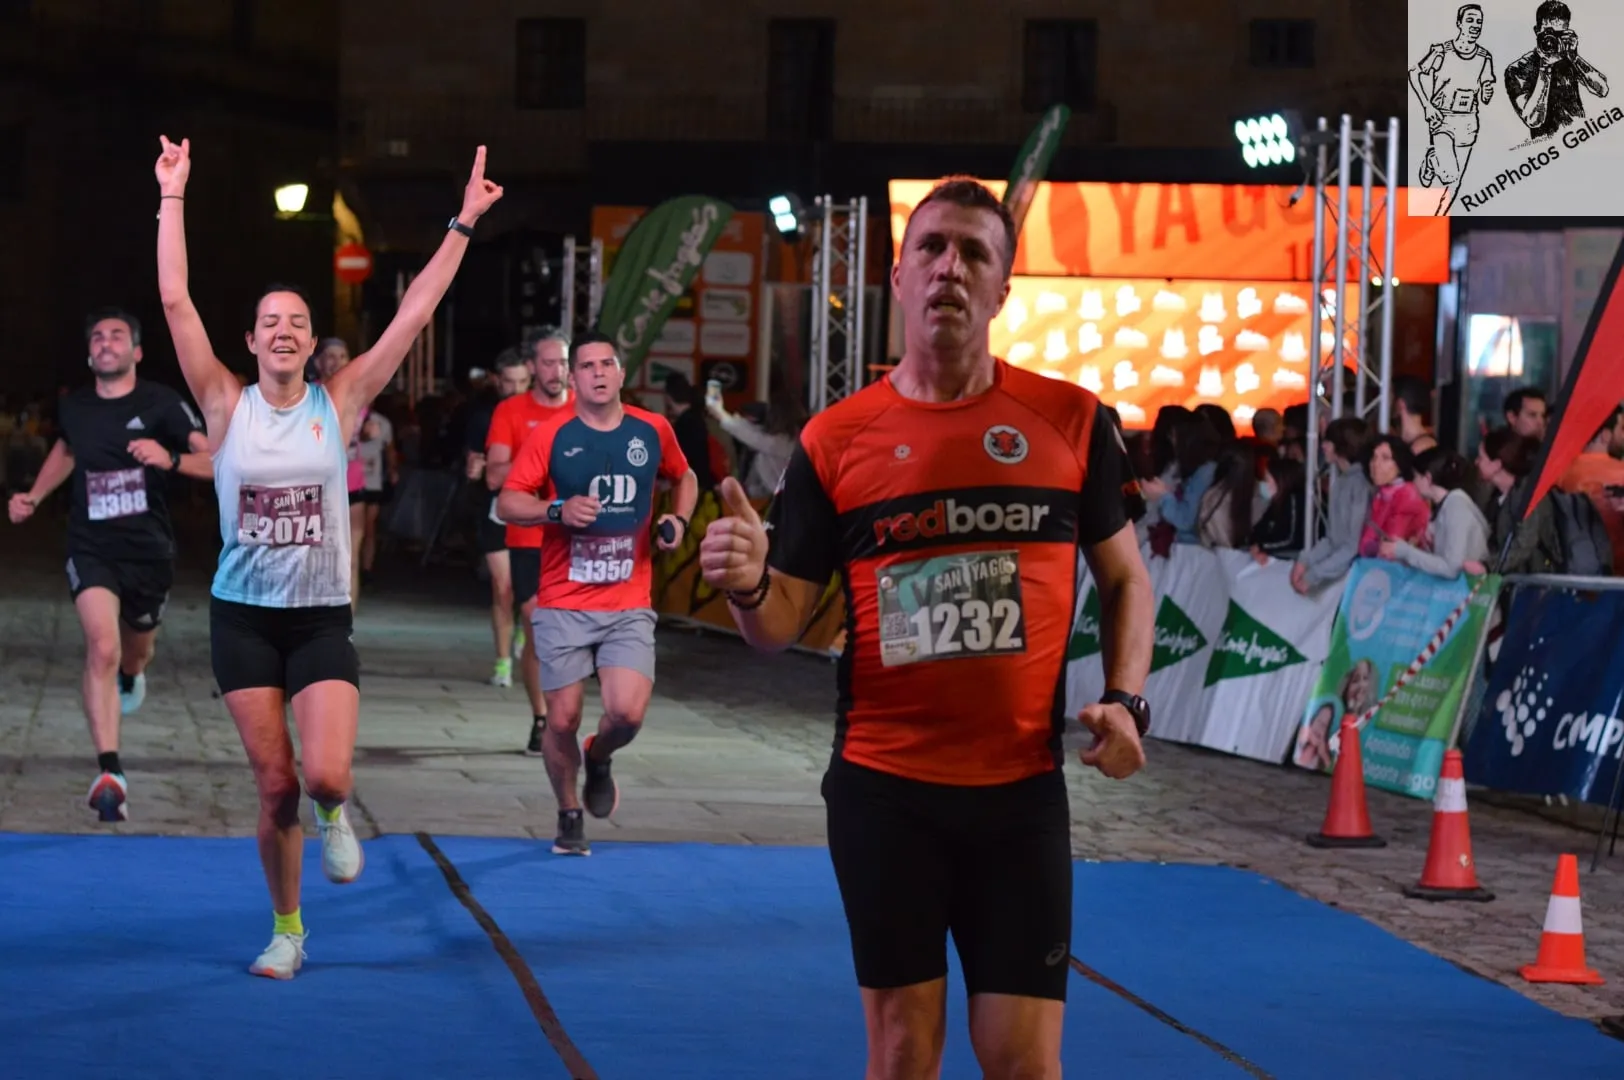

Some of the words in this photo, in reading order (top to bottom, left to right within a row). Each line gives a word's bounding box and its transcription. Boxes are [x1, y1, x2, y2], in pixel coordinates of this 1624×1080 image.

[588, 474, 637, 505] CD
[258, 514, 322, 544] 2074
[873, 498, 1050, 546] redboar
[583, 559, 633, 582] 1350
[911, 599, 1023, 655] 1232
[1553, 710, 1624, 760] CMP
